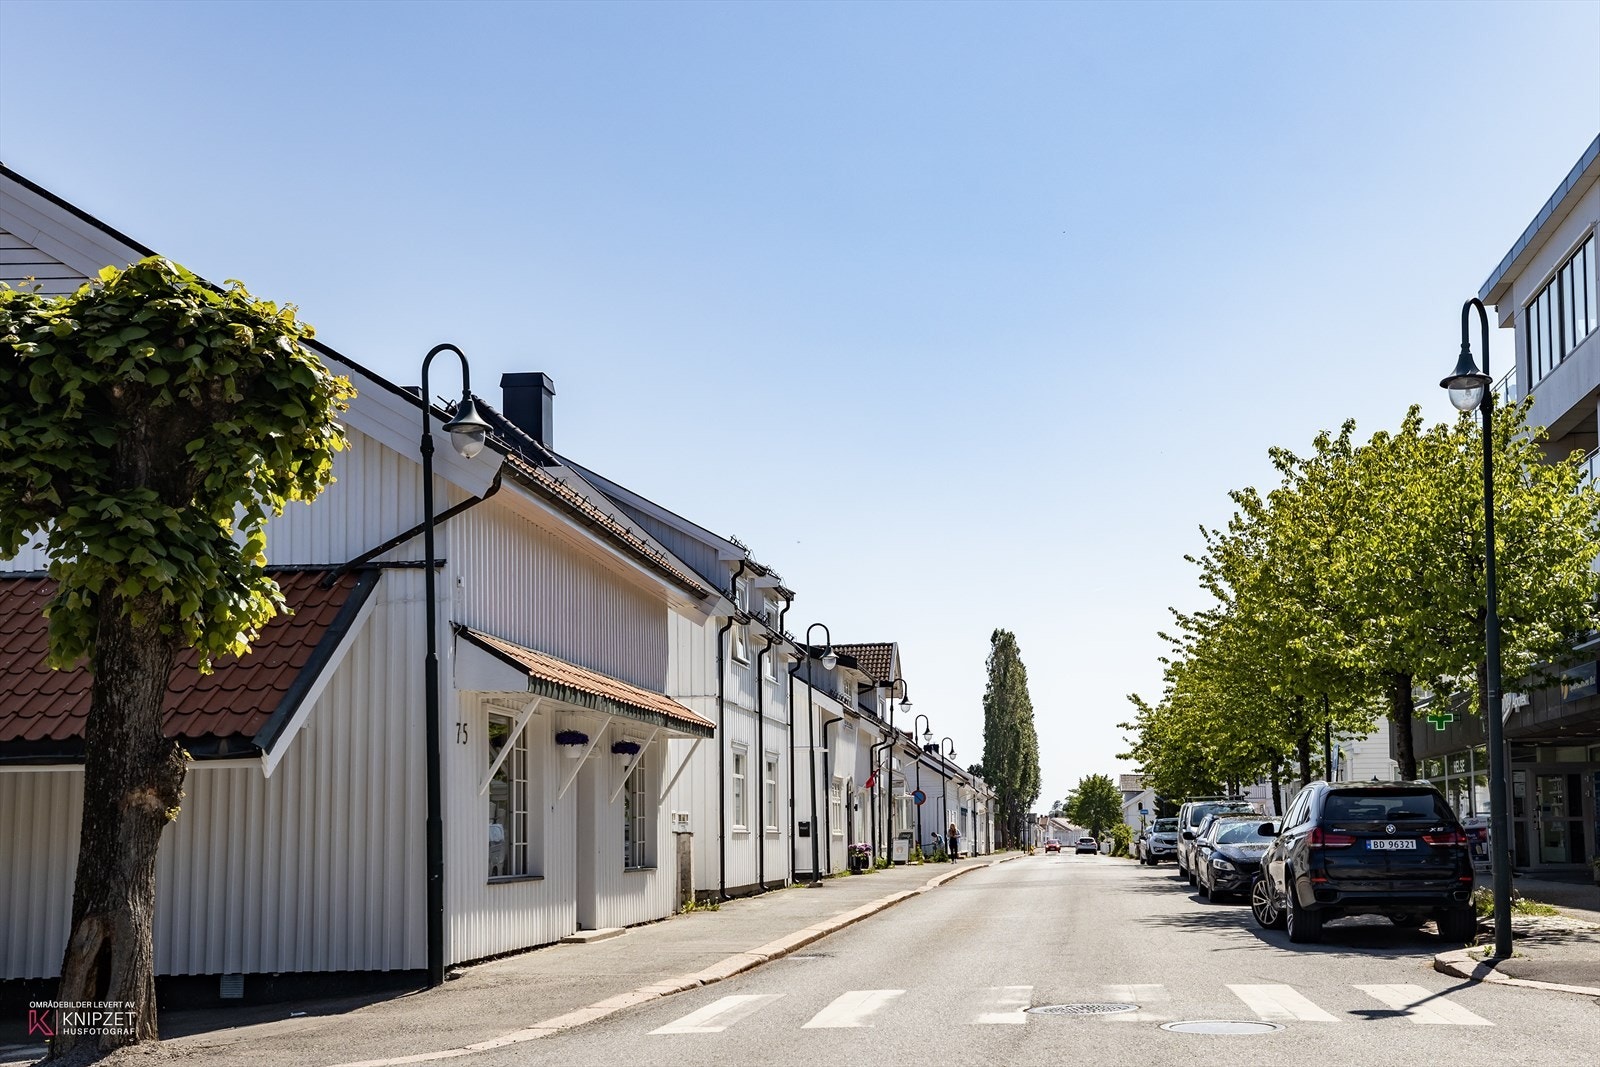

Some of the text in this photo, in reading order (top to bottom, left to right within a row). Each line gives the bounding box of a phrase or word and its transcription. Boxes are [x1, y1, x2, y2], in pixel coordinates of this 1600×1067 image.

[456, 722, 468, 745] 75
[1373, 840, 1385, 849] BD
[1388, 840, 1415, 849] 96321
